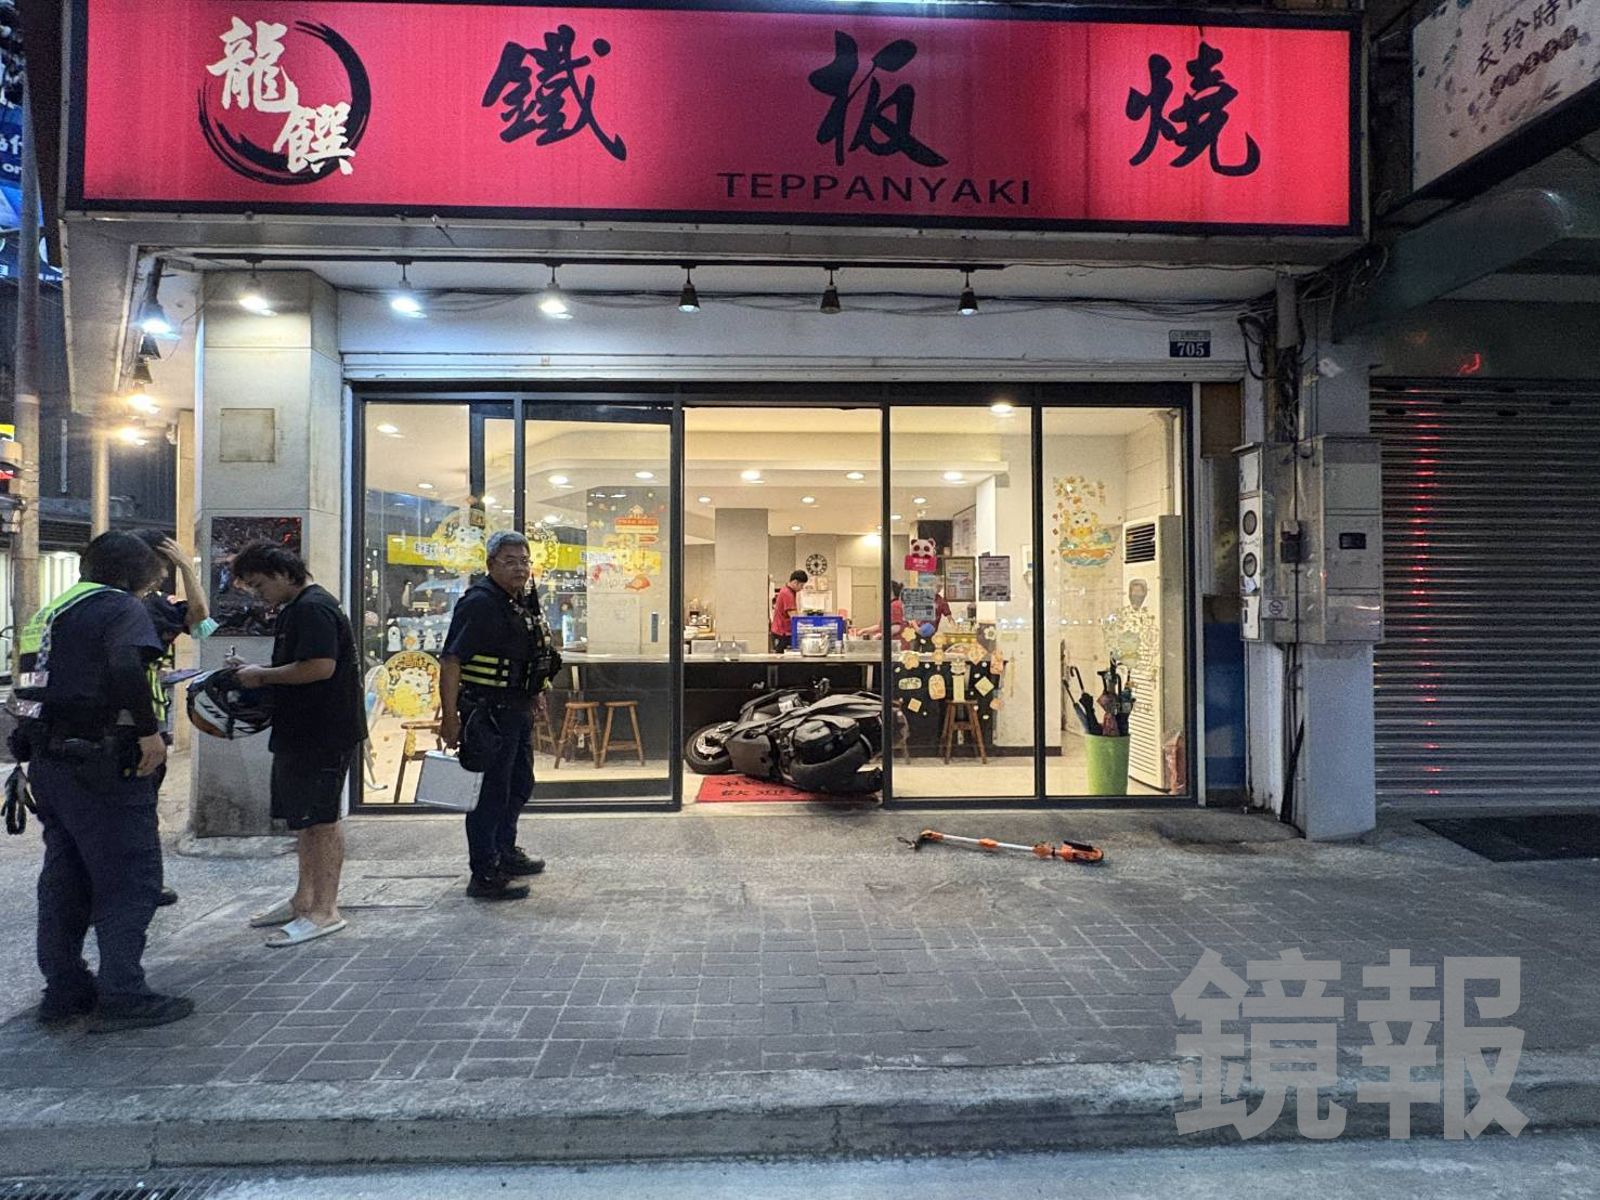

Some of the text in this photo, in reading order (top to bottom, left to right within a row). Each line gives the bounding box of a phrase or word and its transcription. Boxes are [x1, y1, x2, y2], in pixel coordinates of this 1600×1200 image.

[481, 24, 1261, 177] 鐵板燒
[716, 172, 1031, 205] TEPPANYAKI
[1176, 342, 1205, 357] 705
